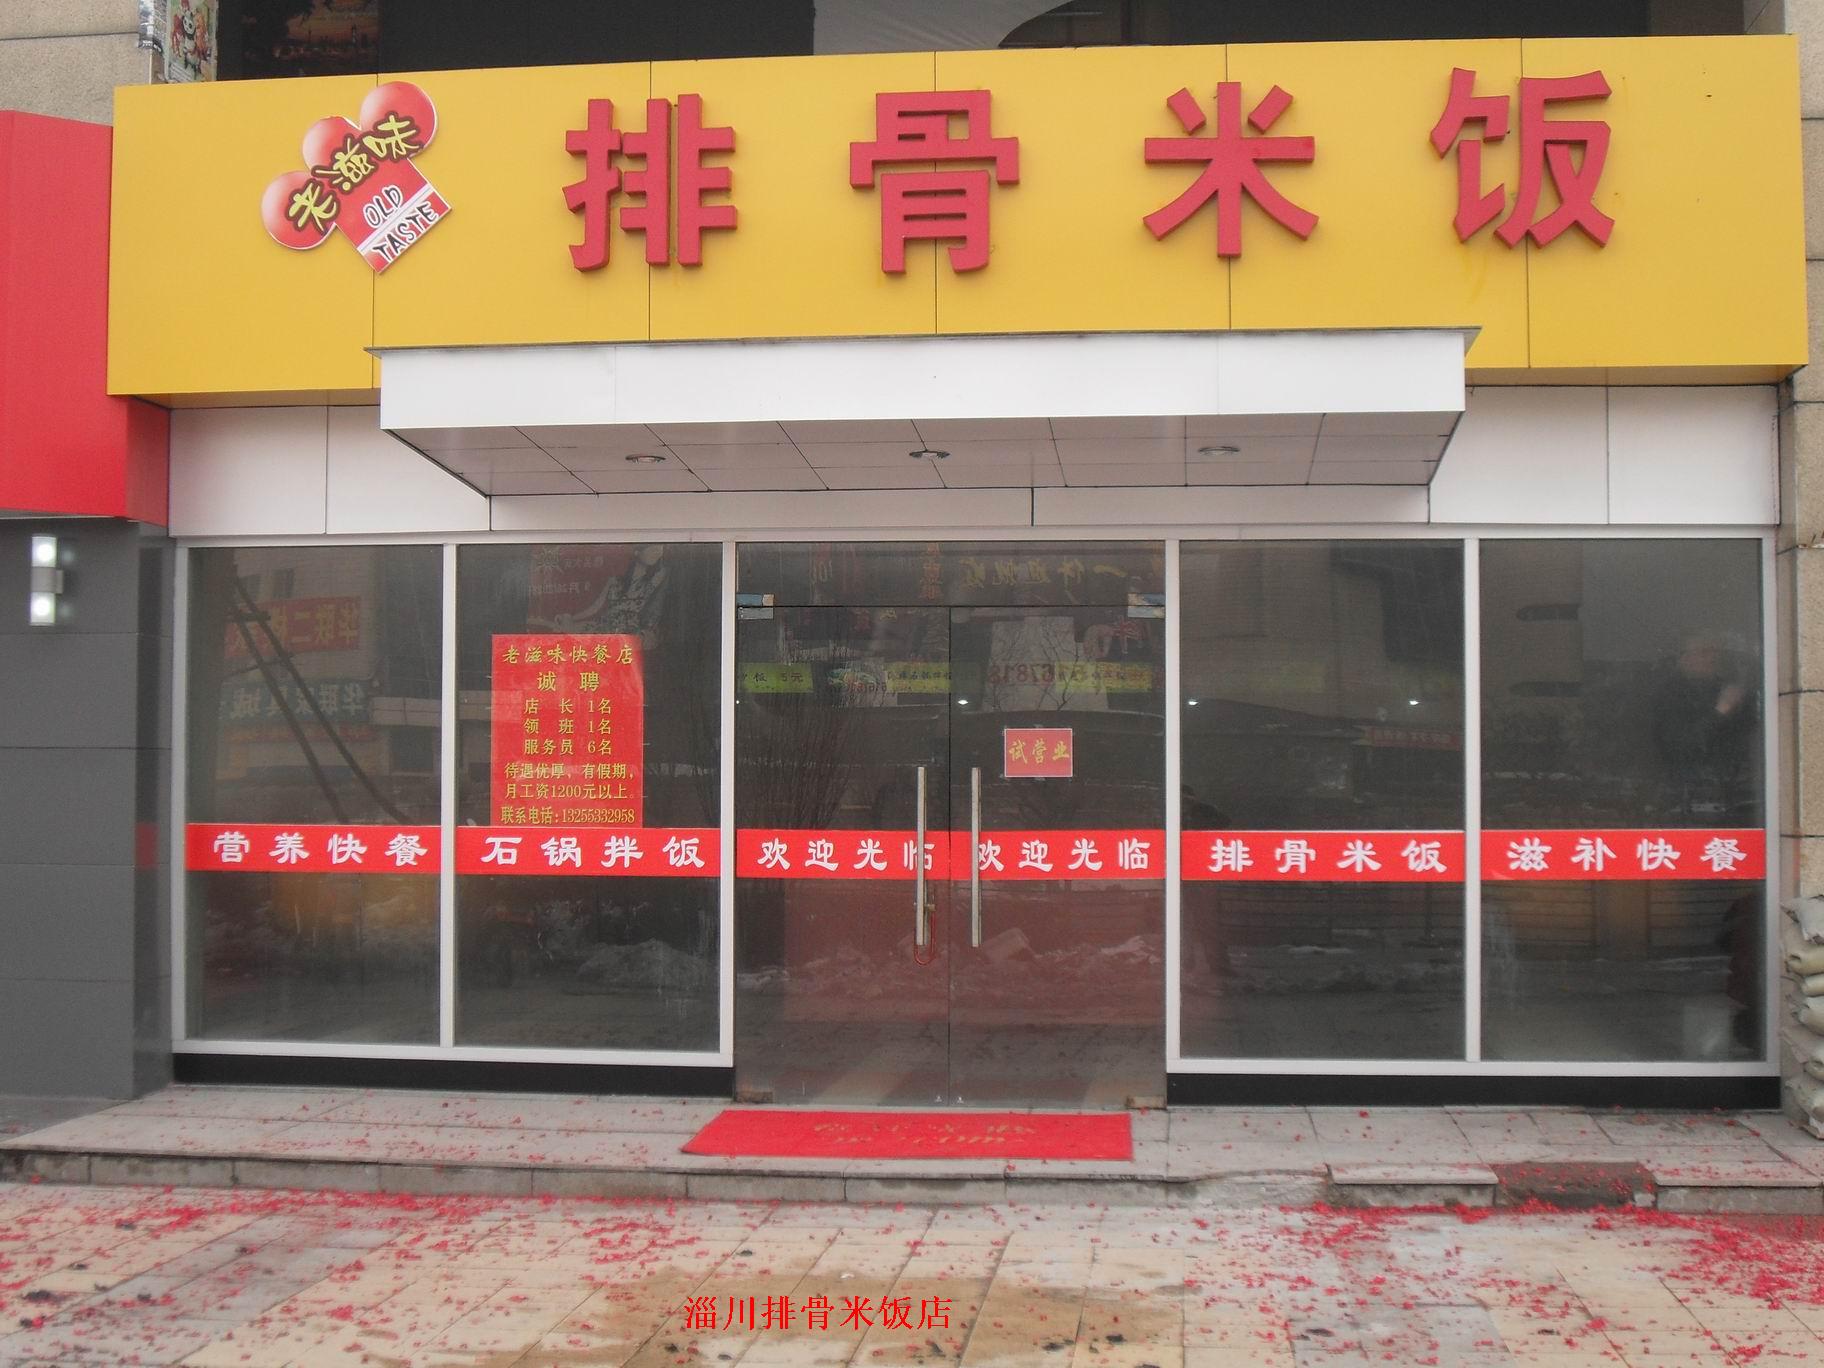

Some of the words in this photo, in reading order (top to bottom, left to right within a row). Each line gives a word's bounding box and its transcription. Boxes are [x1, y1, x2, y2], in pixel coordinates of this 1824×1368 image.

[288, 114, 420, 232] 老滋味
[562, 68, 1614, 276] 排骨米饭
[364, 186, 402, 228] OLD
[371, 202, 439, 262] TASTE
[502, 643, 634, 665] 老滋味快餐店
[536, 671, 601, 692] 诚聘
[1008, 739, 1070, 764] 试营业
[213, 831, 428, 867] 营养快餐
[480, 836, 706, 869] 石锅拌饭
[978, 838, 1151, 873] 欢迎光临
[1208, 838, 1448, 873] 排骨米饭
[1507, 837, 1748, 873] 滋补快餐
